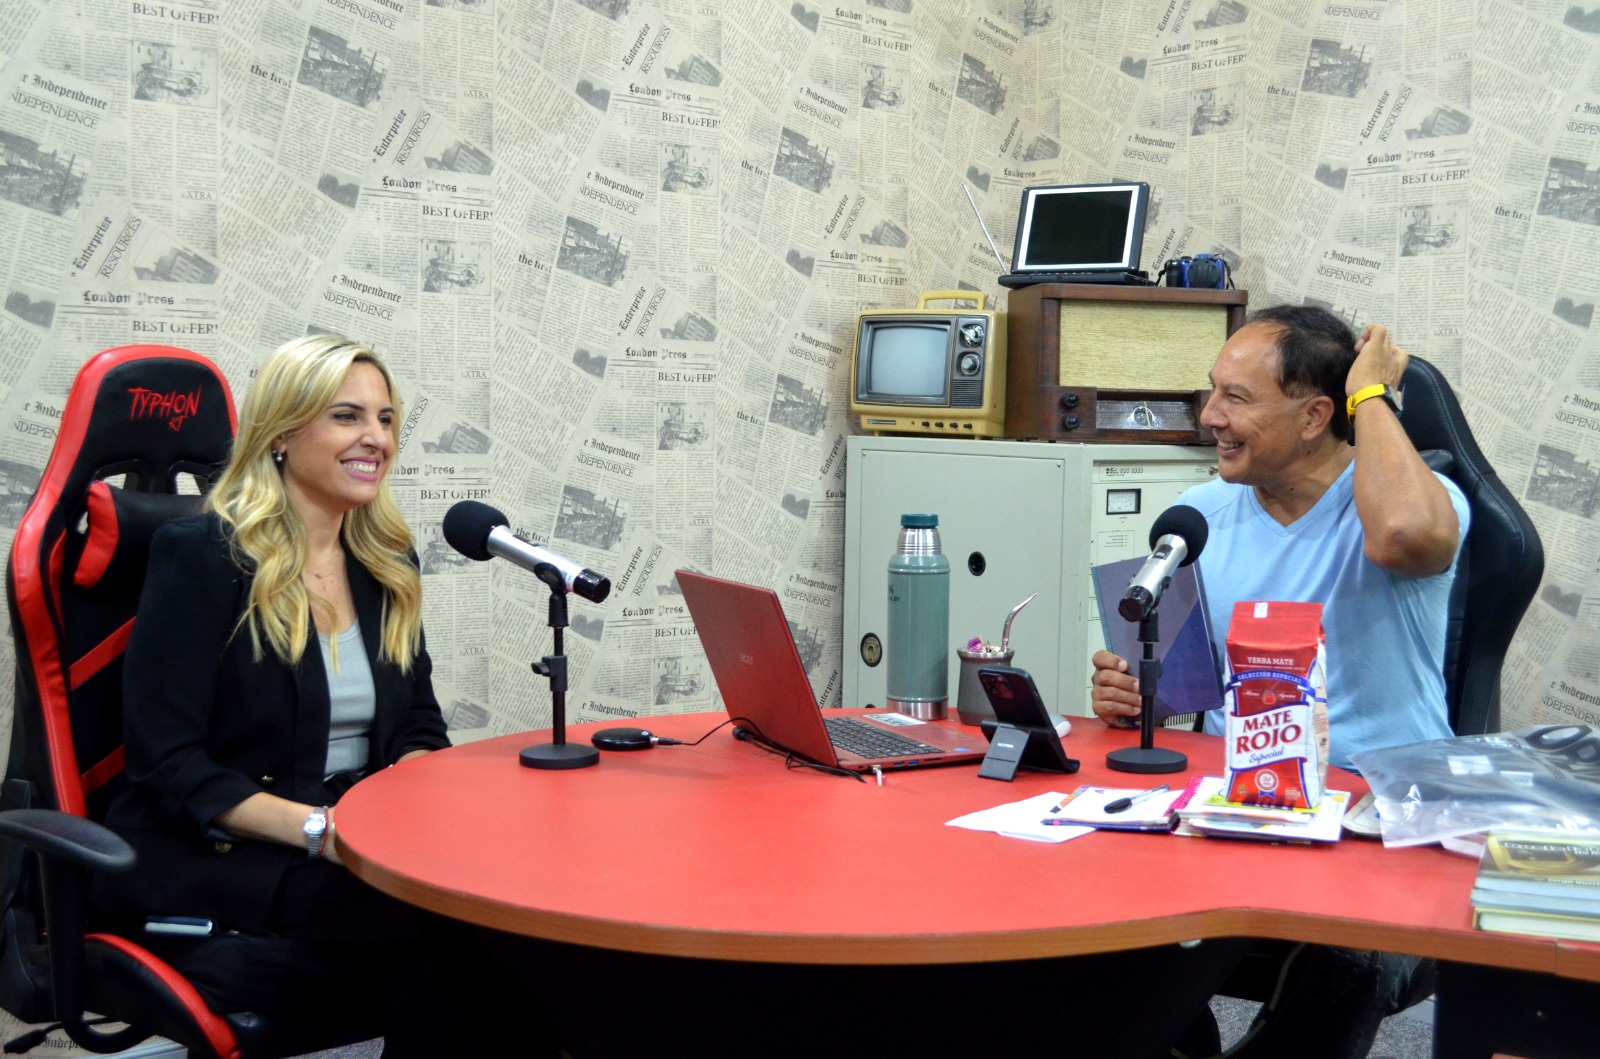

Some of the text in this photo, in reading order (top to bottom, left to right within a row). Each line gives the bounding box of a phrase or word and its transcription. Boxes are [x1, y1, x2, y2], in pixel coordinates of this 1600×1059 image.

[132, 2, 167, 18] BEST
[835, 8, 863, 21] London
[983, 15, 1019, 43] Independence
[862, 34, 882, 46] BEST
[1162, 41, 1191, 56] London
[640, 27, 671, 75] RESOURCES
[1191, 60, 1213, 72] BEST
[250, 63, 292, 89] the first
[31, 74, 108, 111] Independence
[629, 83, 662, 96] London
[928, 82, 939, 94] the
[1267, 85, 1297, 97] the first
[805, 87, 848, 115] Independence
[661, 111, 686, 124] BEST
[1379, 86, 1412, 143] RESOURCES
[396, 111, 432, 167] RESOURCES
[1134, 133, 1176, 150] Independence
[1367, 152, 1401, 166] London
[741, 160, 770, 179] the first
[382, 175, 422, 189] London
[594, 171, 645, 200] Independence
[1401, 174, 1428, 185] BEST
[421, 204, 451, 219] BEST
[840, 195, 866, 241] RESOURCES
[1494, 205, 1532, 222] the first
[100, 216, 142, 279] RESOURCES
[830, 249, 858, 260] London
[518, 253, 552, 274] the first
[1331, 249, 1382, 270] Independence
[857, 273, 877, 284] BEST
[83, 290, 131, 304] London
[340, 274, 402, 304] Independence
[636, 287, 666, 338] RESOURCES
[132, 320, 167, 333] BEST
[800, 332, 843, 356] Independence
[625, 347, 658, 359] London
[657, 371, 681, 382] BEST
[127, 384, 203, 422] TYPHON
[737, 410, 765, 427] the first
[590, 438, 641, 462] Independence
[420, 489, 448, 500] BEST
[516, 527, 550, 545] the first
[633, 545, 663, 597] RESOURCES
[795, 574, 838, 592] Independence
[622, 607, 655, 620] London
[654, 627, 678, 638] BEST
[1247, 656, 1294, 666] YERBA MATE
[1237, 670, 1302, 684] SELECCIÓN ESPECIAL
[589, 700, 638, 718] Independence
[1243, 709, 1292, 733] MATE
[1235, 724, 1302, 755] ROJO
[1249, 746, 1285, 765] Especial
